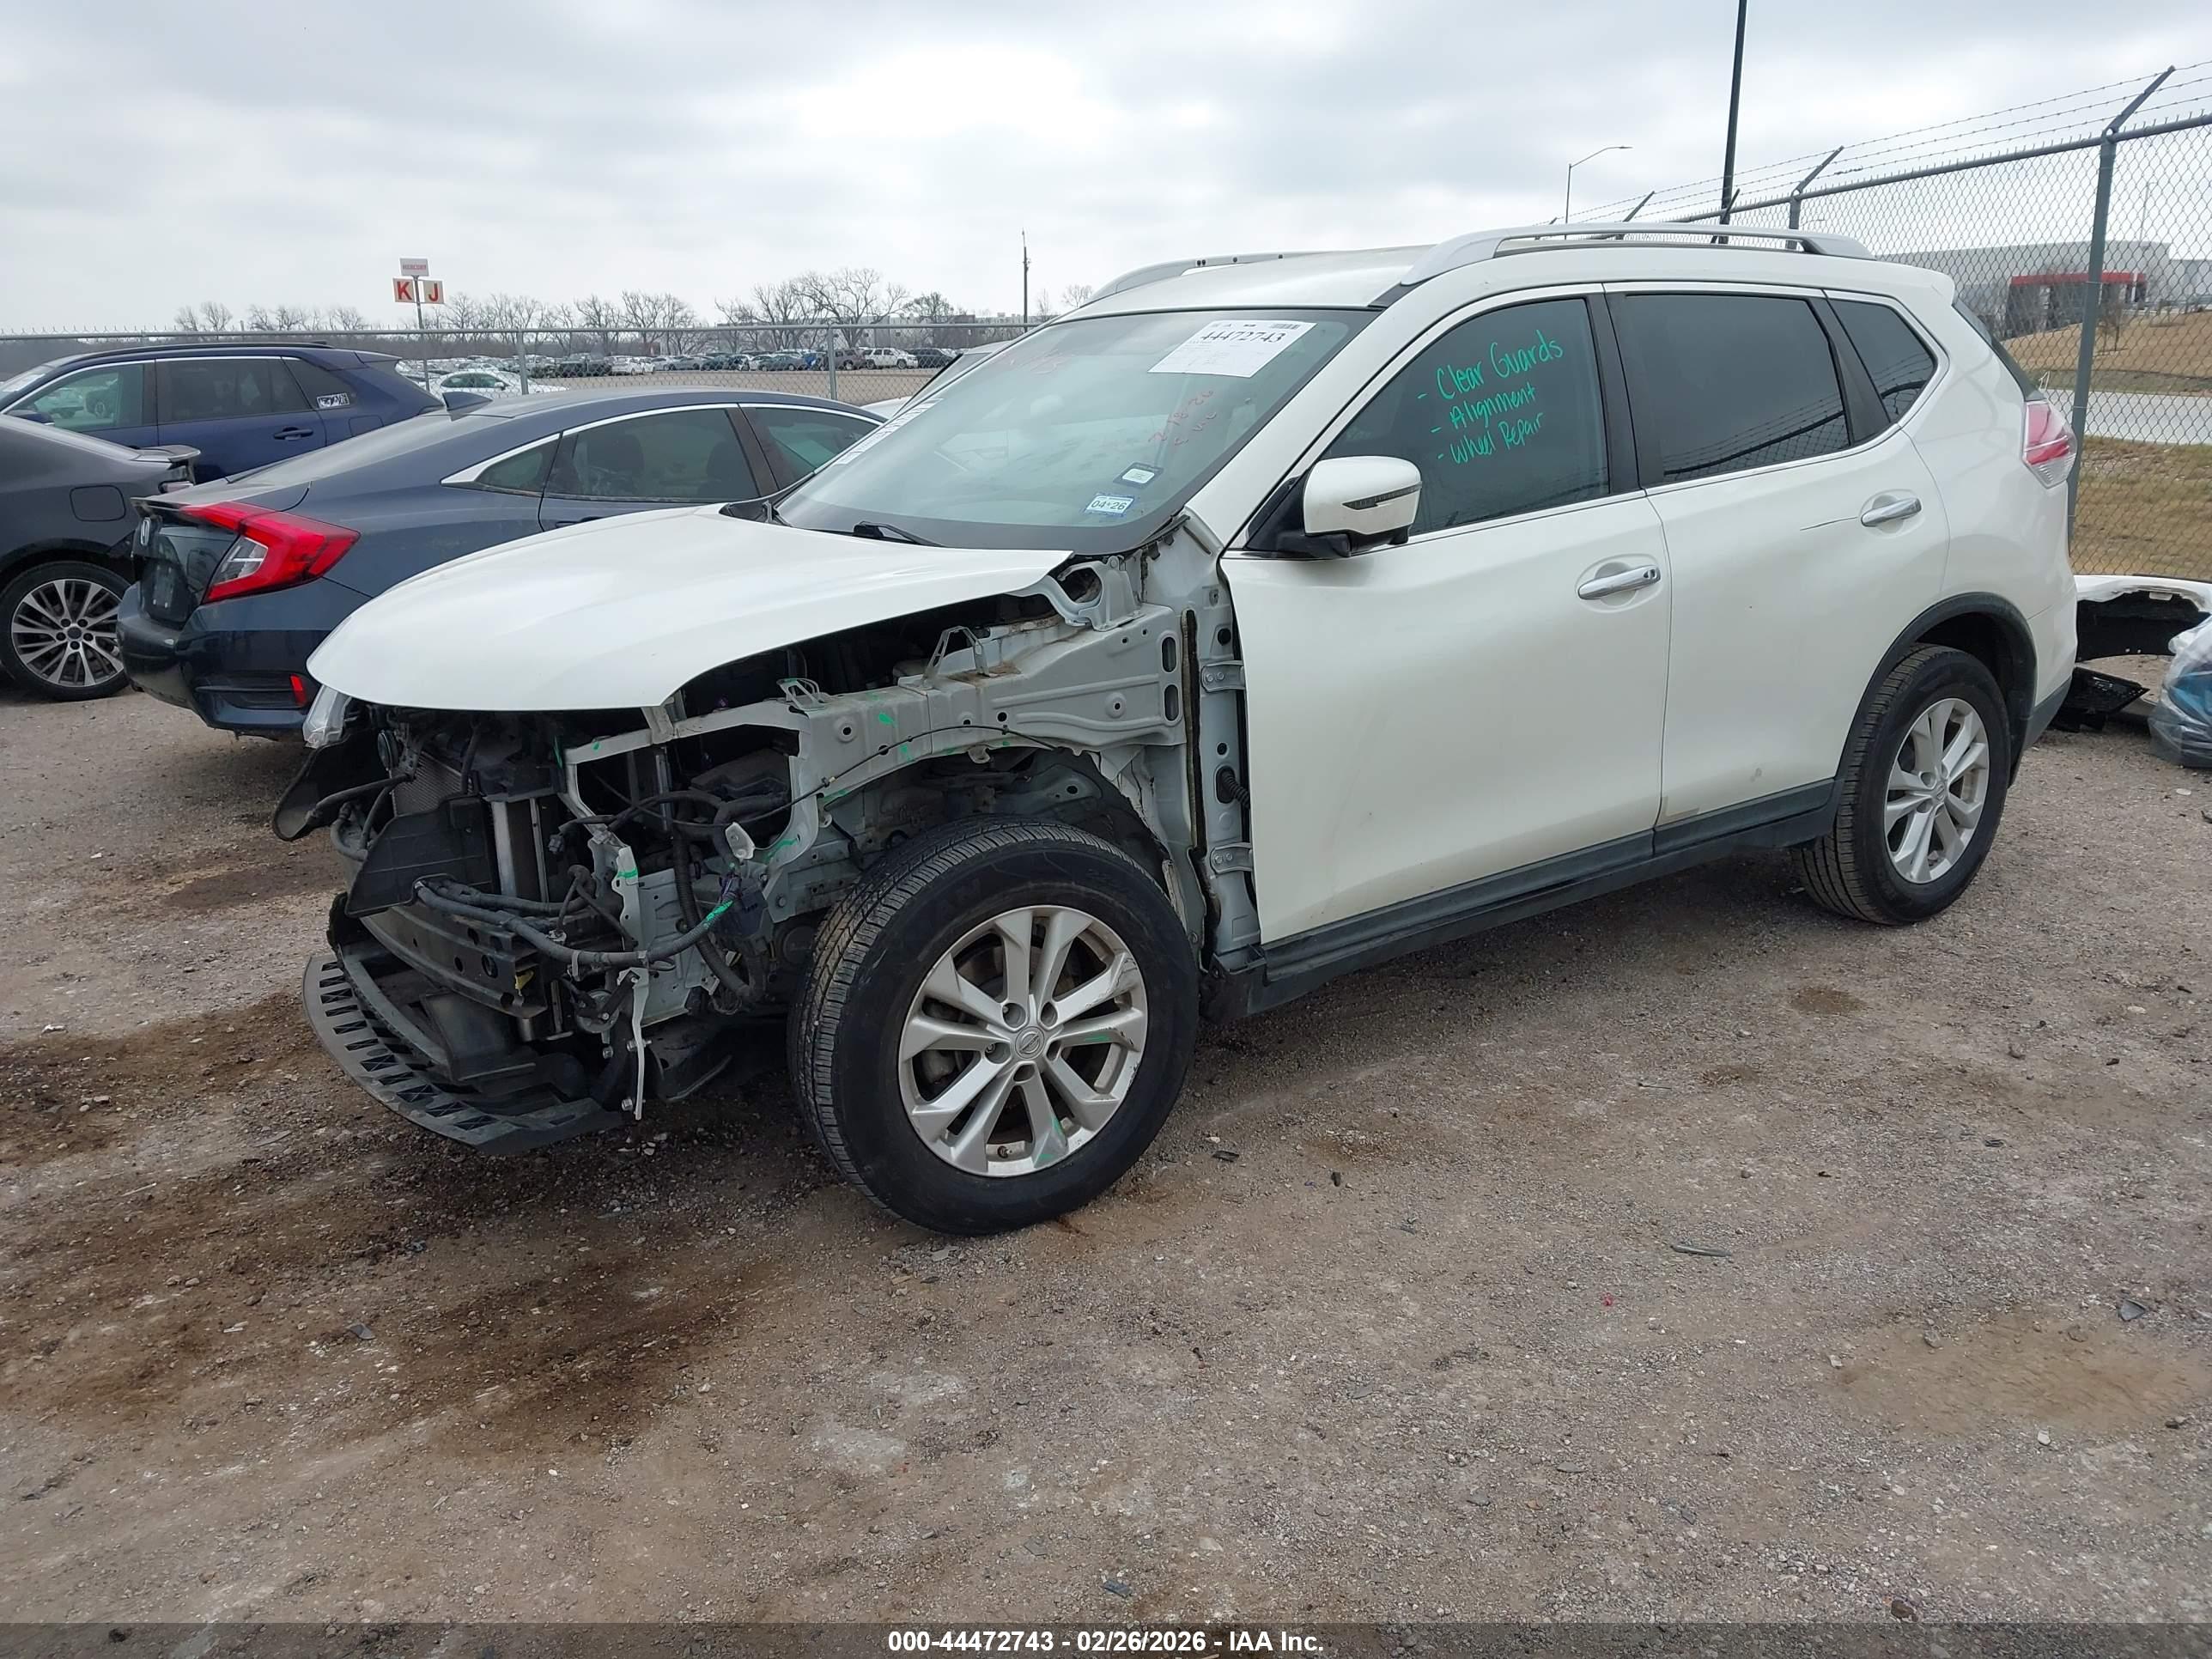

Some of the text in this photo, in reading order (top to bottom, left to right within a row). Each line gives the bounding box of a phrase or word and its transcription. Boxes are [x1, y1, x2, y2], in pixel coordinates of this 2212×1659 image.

[397, 281, 412, 301] K
[428, 283, 439, 301] J
[1200, 331, 1286, 343] 44472743
[1437, 361, 1485, 399] Clear
[1490, 329, 1564, 378] Guards
[1449, 381, 1536, 430] Alignment
[1450, 430, 1497, 464] Wheel
[1498, 412, 1544, 450] Repair
